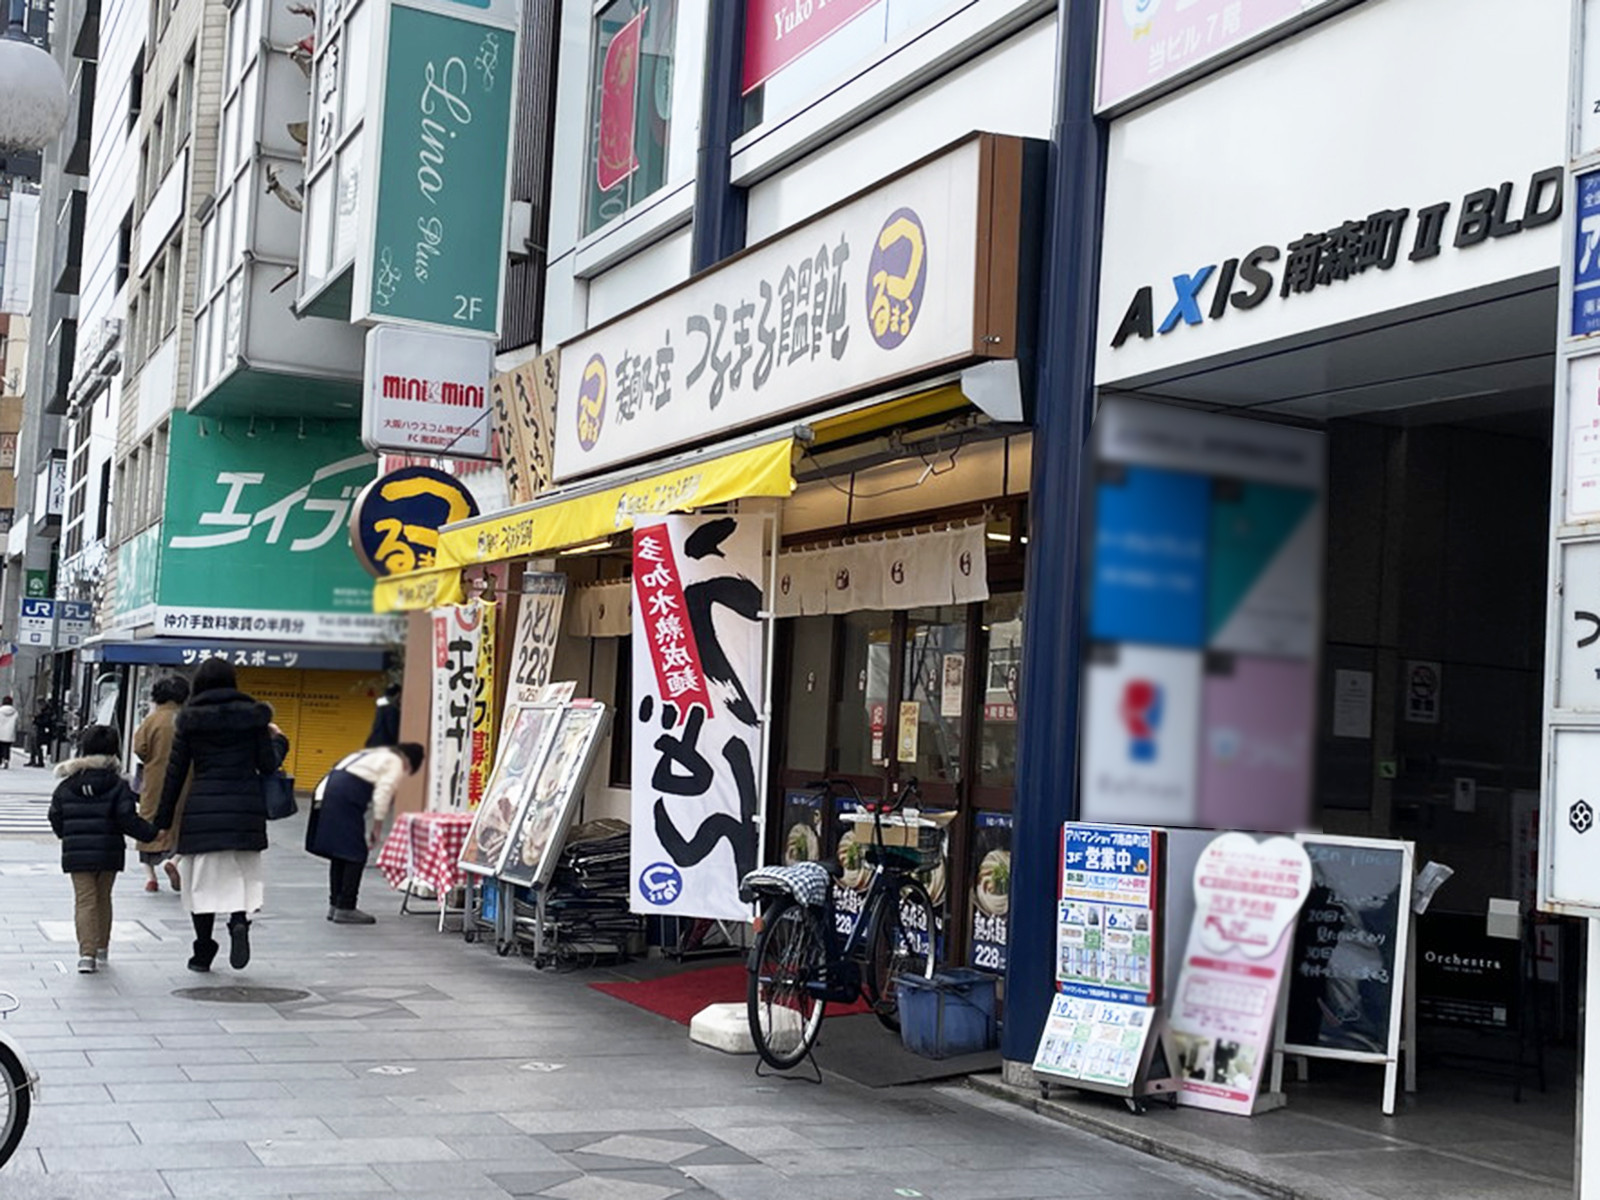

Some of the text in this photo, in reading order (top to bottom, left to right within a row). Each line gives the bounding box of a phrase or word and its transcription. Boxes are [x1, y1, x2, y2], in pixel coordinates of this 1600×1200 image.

[774, 0, 813, 40] Yuko
[413, 56, 470, 284] Lino Plus
[1111, 245, 1280, 348] AXIS
[1280, 207, 1409, 298] 南森町
[453, 295, 483, 321] 2F
[26, 602, 51, 616] JR
[164, 613, 304, 634] 仲介手数料家賃の半月分
[522, 599, 558, 646] うどん
[234, 650, 299, 667] スポーツ
[515, 646, 550, 688] 228
[1066, 845, 1131, 872] 3F 営業中
[974, 944, 999, 969] 228
[1424, 950, 1502, 969] Orchestra
